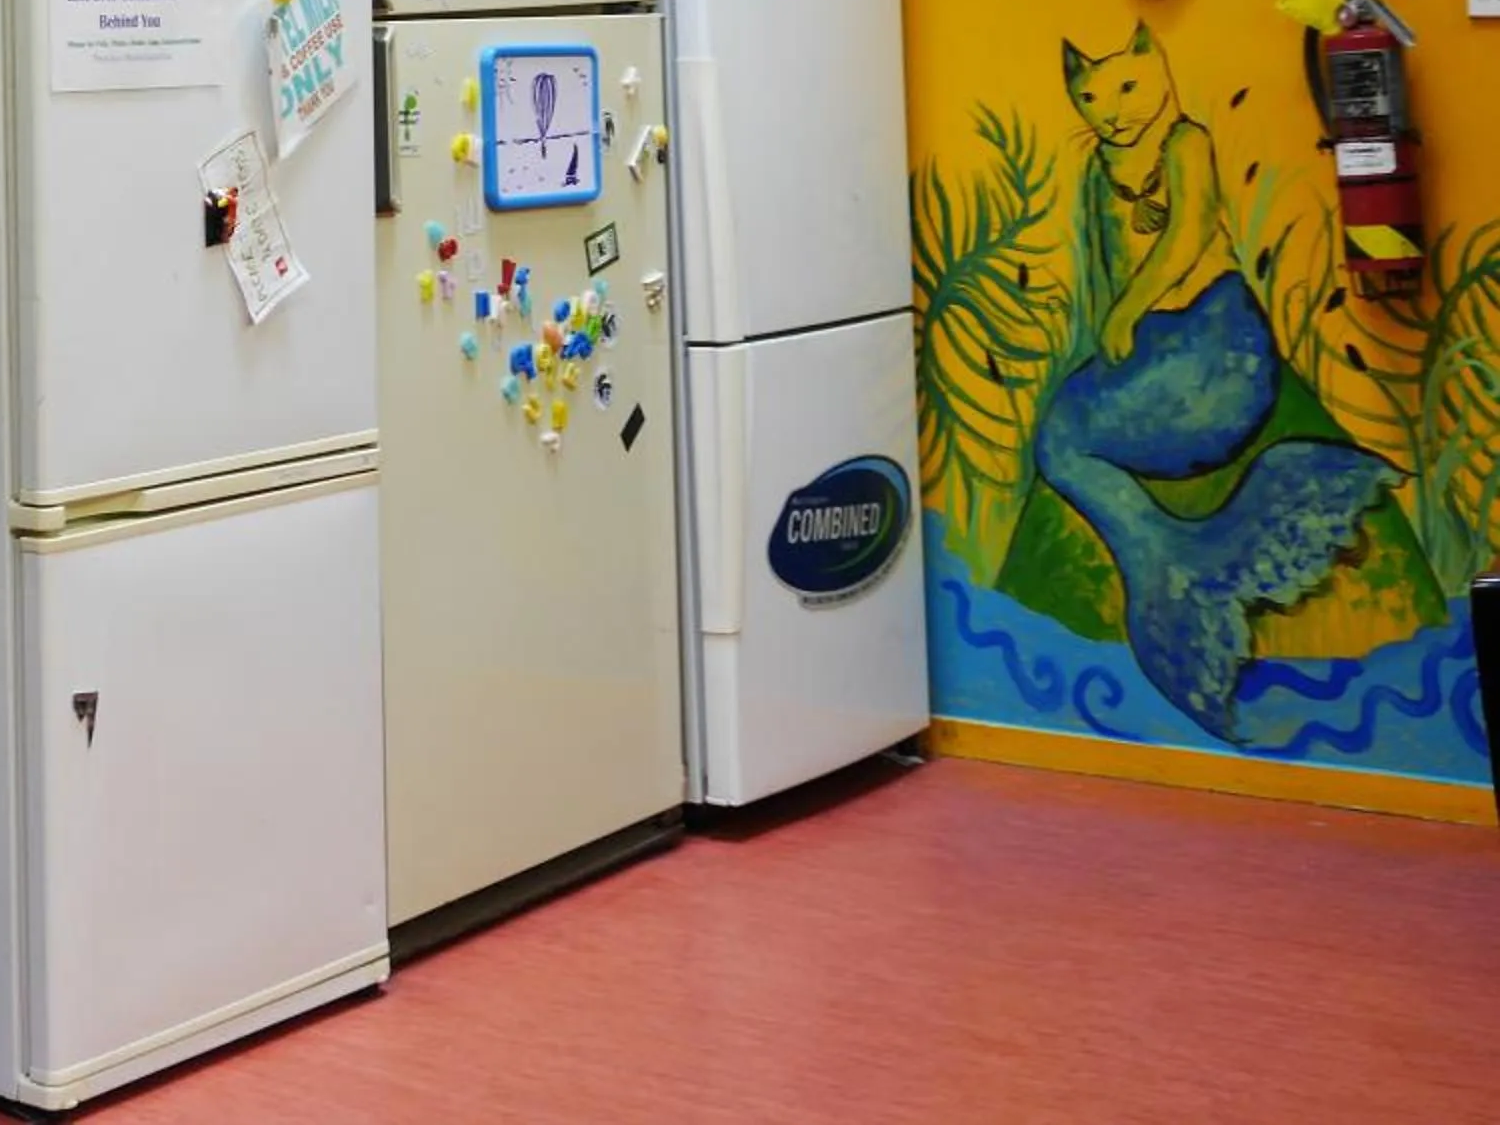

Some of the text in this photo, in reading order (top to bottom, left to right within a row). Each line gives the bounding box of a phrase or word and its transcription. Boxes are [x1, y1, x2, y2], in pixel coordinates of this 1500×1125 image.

[99, 13, 161, 28] Behind You
[787, 502, 881, 545] COMBINED
